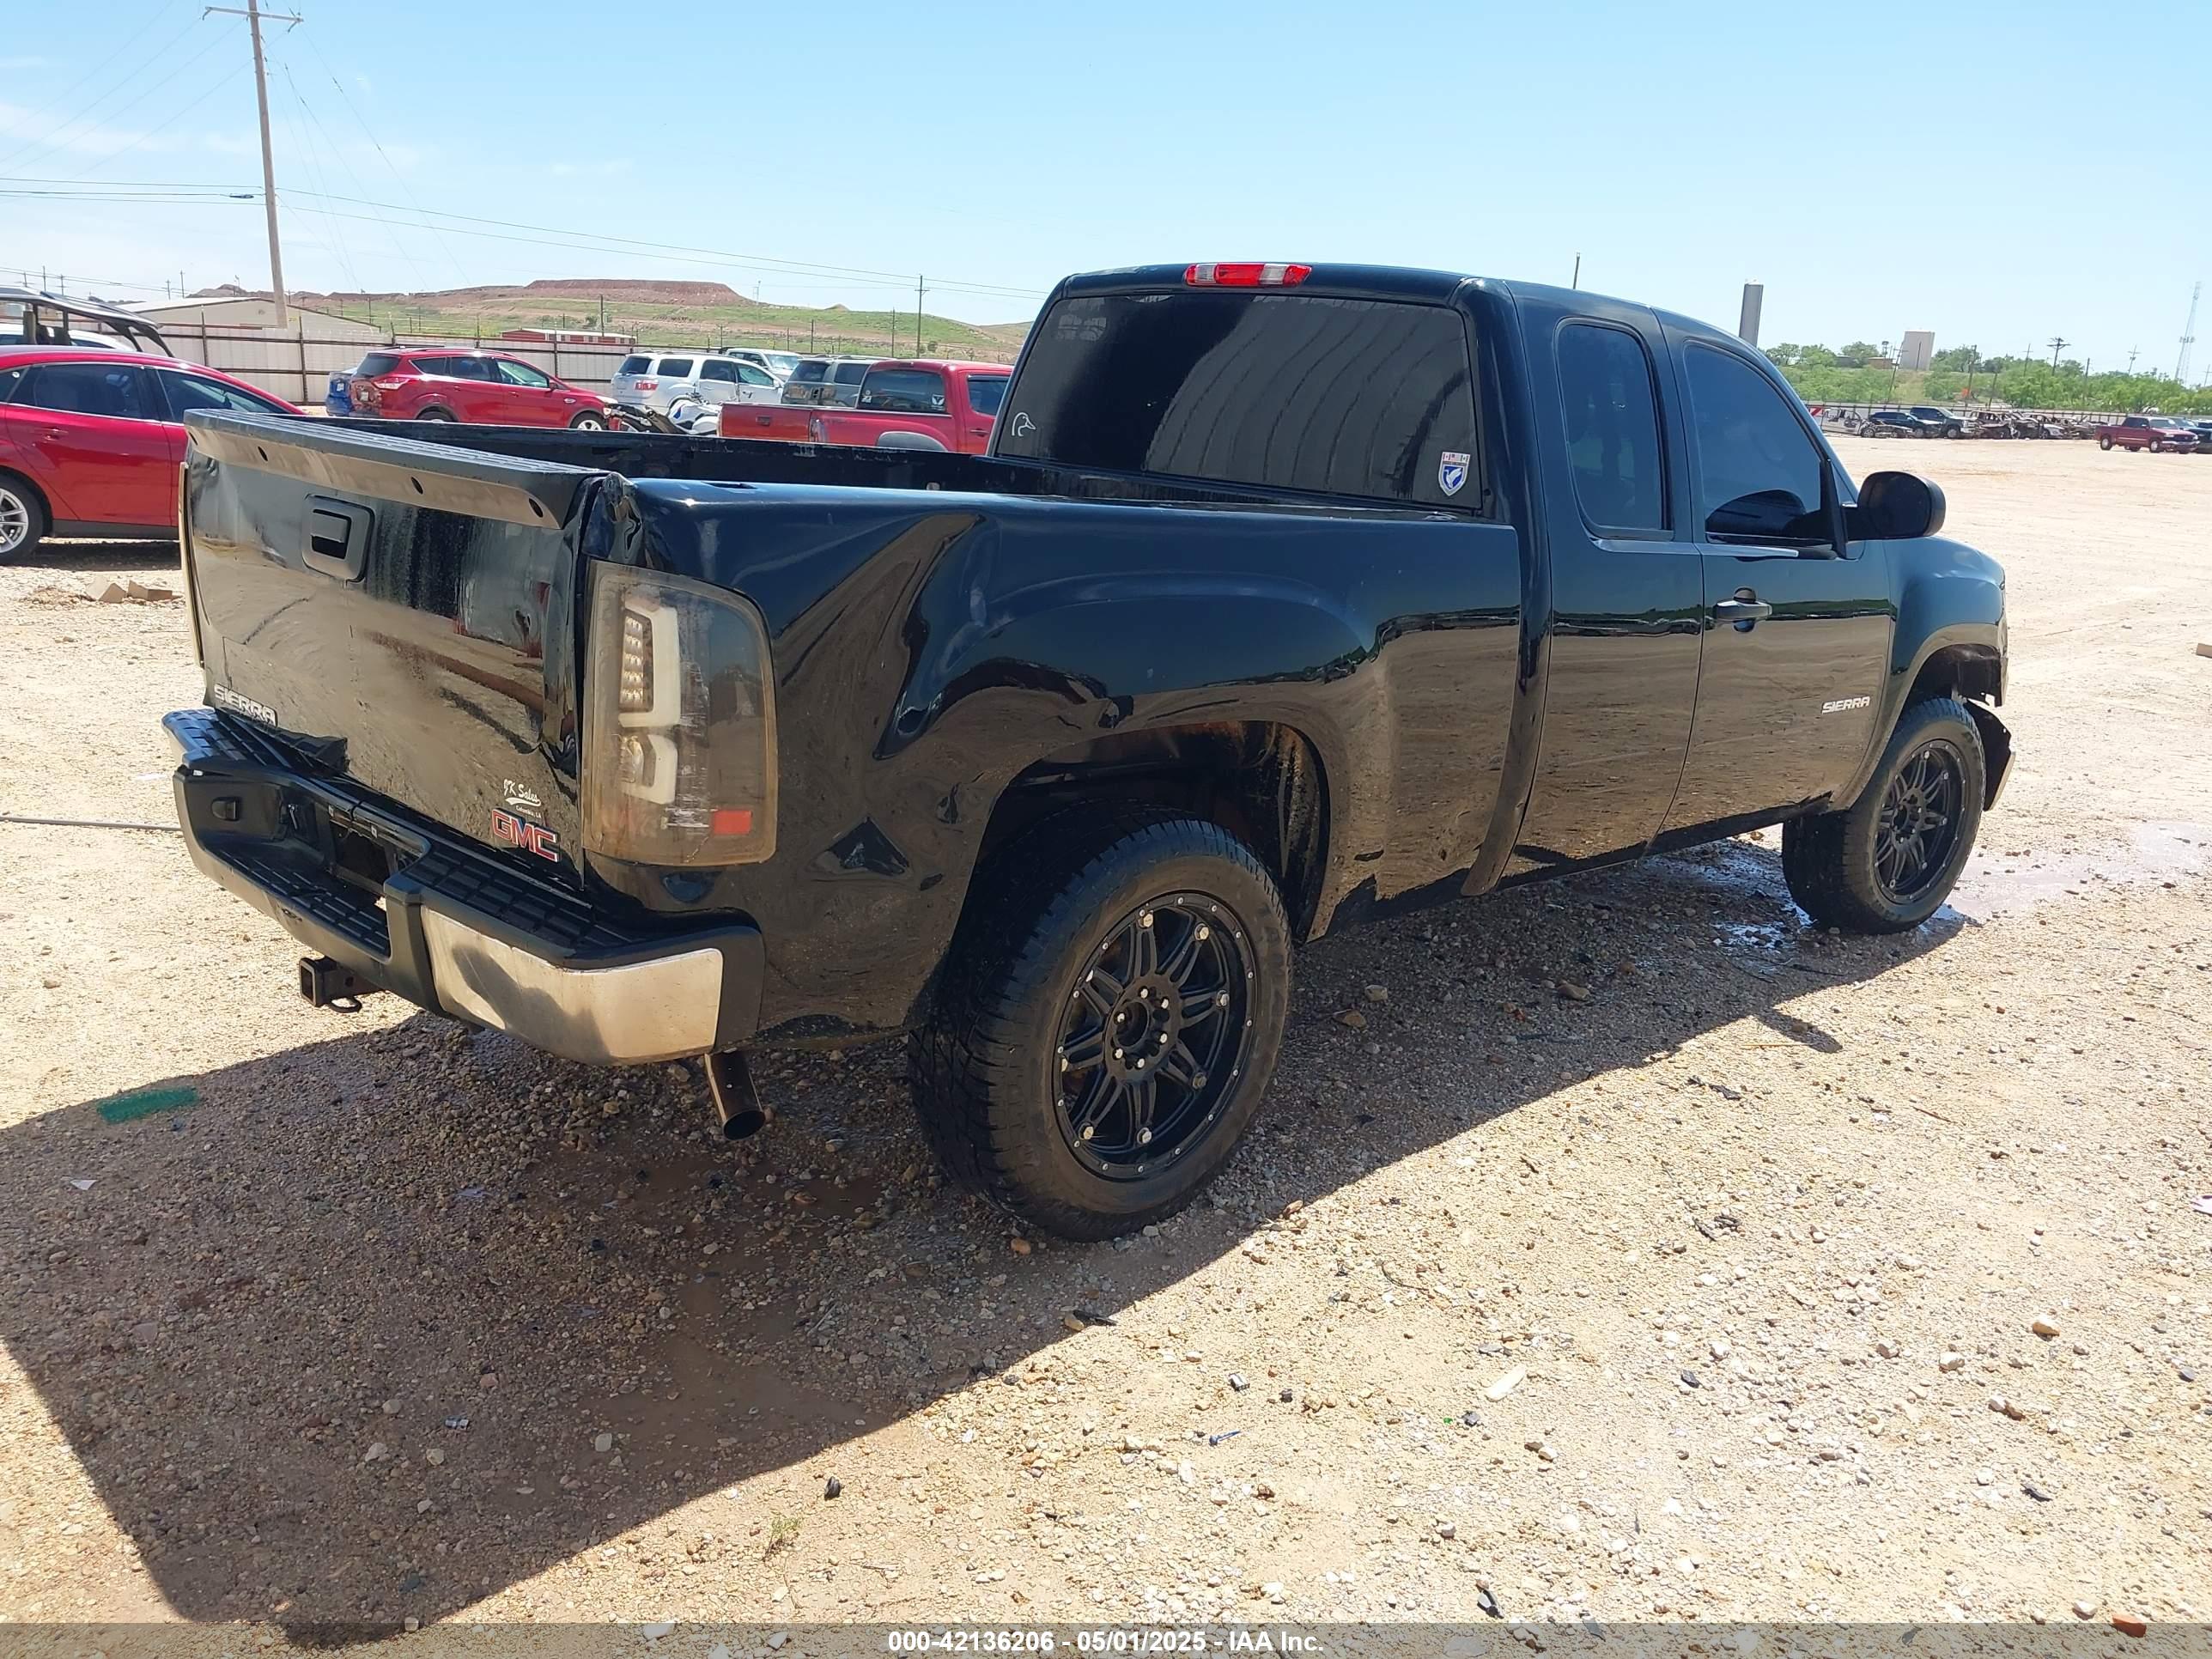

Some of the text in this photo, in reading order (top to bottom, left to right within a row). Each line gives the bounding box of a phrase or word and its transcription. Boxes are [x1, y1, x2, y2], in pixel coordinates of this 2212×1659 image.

[214, 684, 276, 726] SIERRA
[1821, 696, 1870, 714] SIERRA
[519, 783, 538, 803] Sales
[492, 809, 558, 862] GMC
